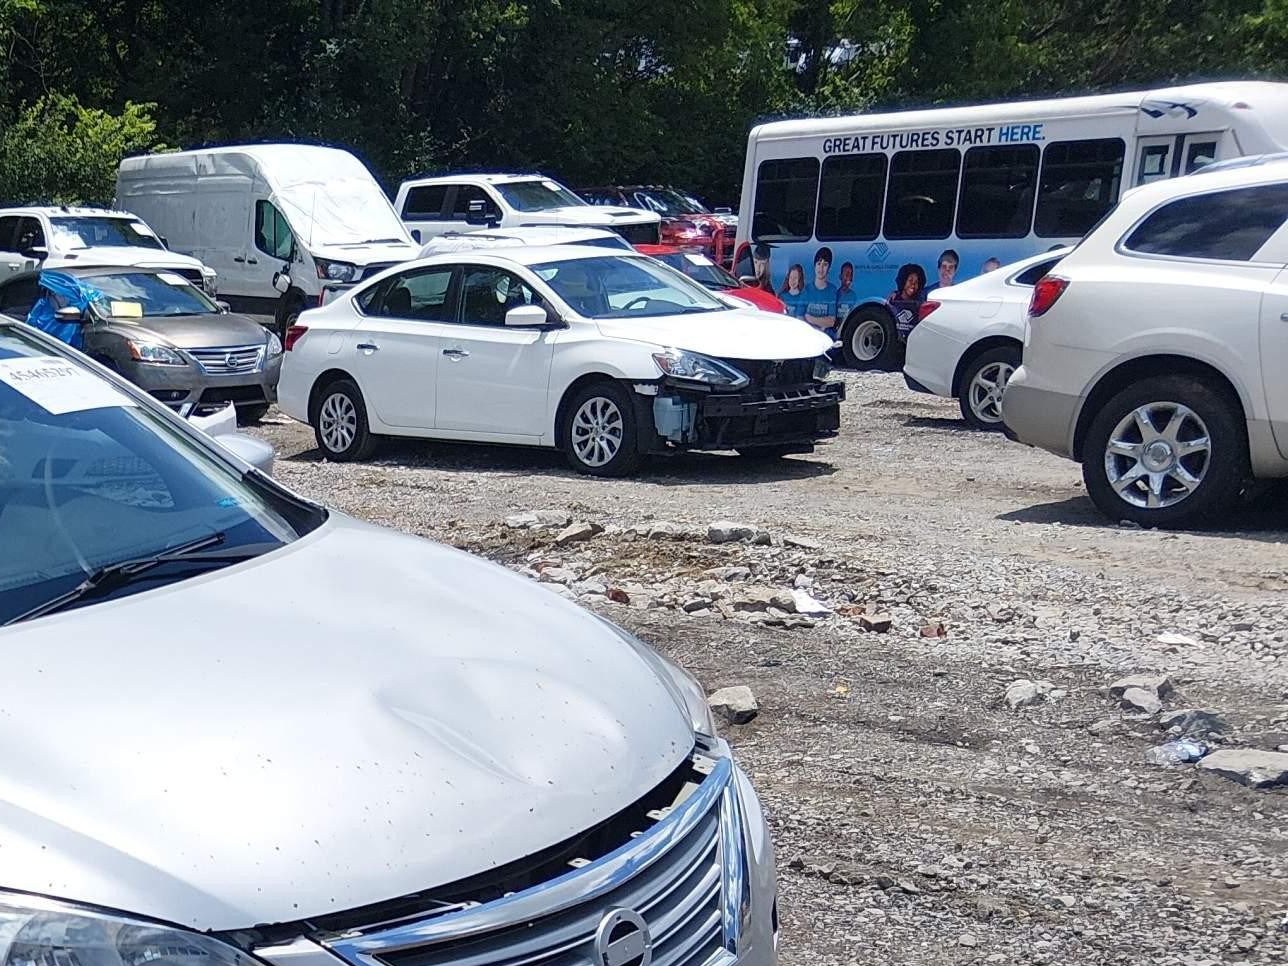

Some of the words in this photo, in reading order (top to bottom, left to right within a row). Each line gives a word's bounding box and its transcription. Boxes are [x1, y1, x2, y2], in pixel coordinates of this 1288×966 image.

[823, 135, 869, 154] GREAT
[871, 131, 940, 151] FUTURES
[944, 127, 995, 146] START
[998, 124, 1046, 143] HERE.
